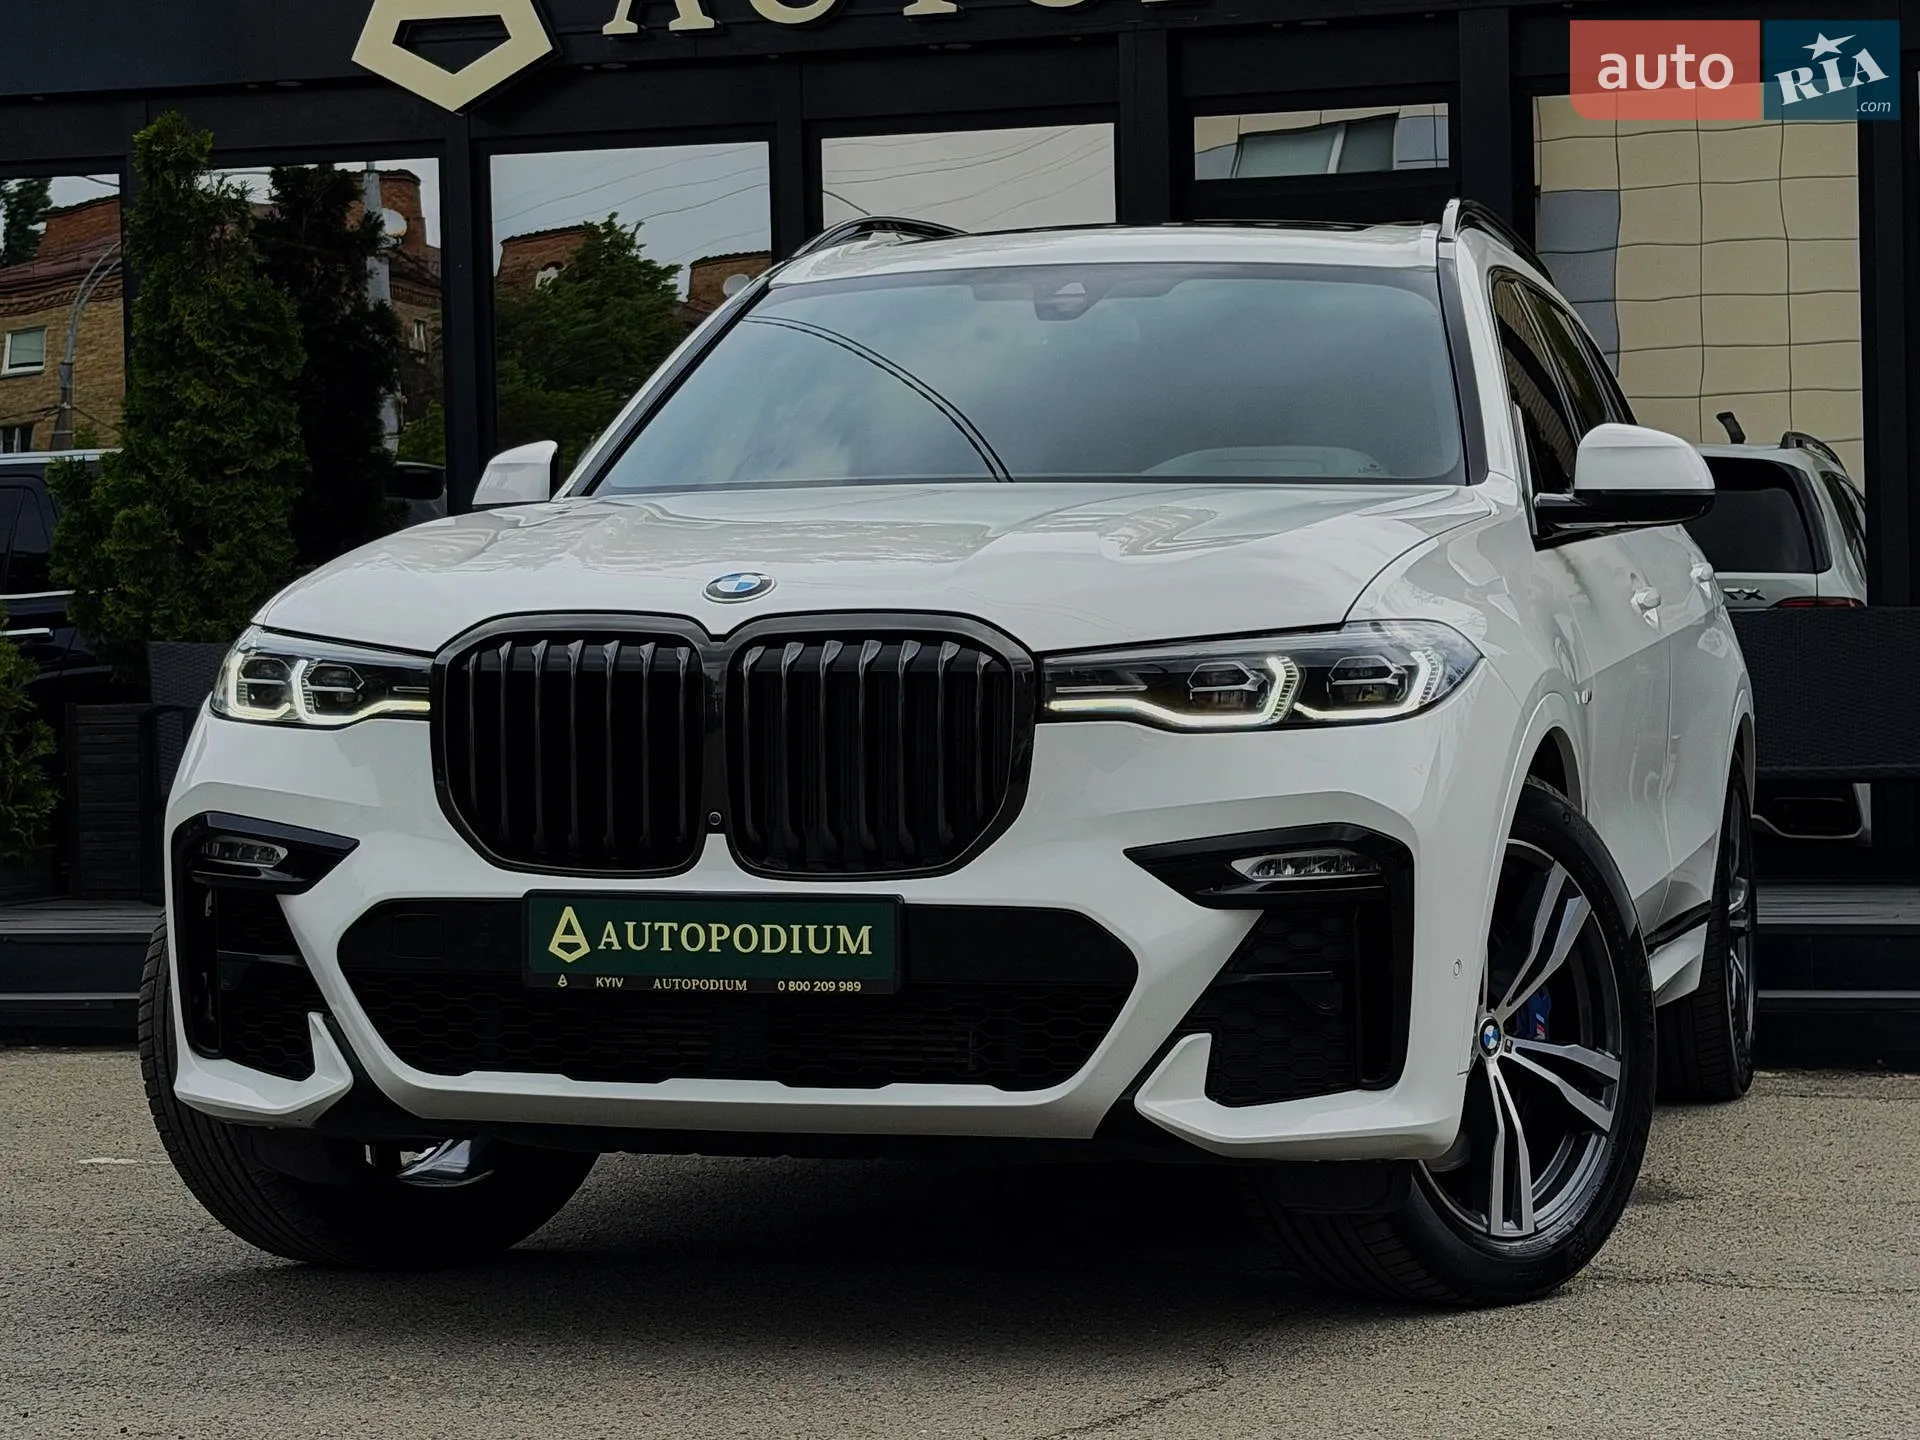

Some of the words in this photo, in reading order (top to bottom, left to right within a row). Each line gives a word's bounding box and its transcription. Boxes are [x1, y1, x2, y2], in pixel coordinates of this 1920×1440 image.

[597, 920, 873, 955] AUTOPODIUM
[595, 976, 625, 988] KYIV
[652, 978, 748, 992] AUTOPODIUM
[777, 980, 786, 992] 0
[788, 980, 811, 992] 800
[813, 980, 836, 992] 209
[838, 980, 862, 992] 989
